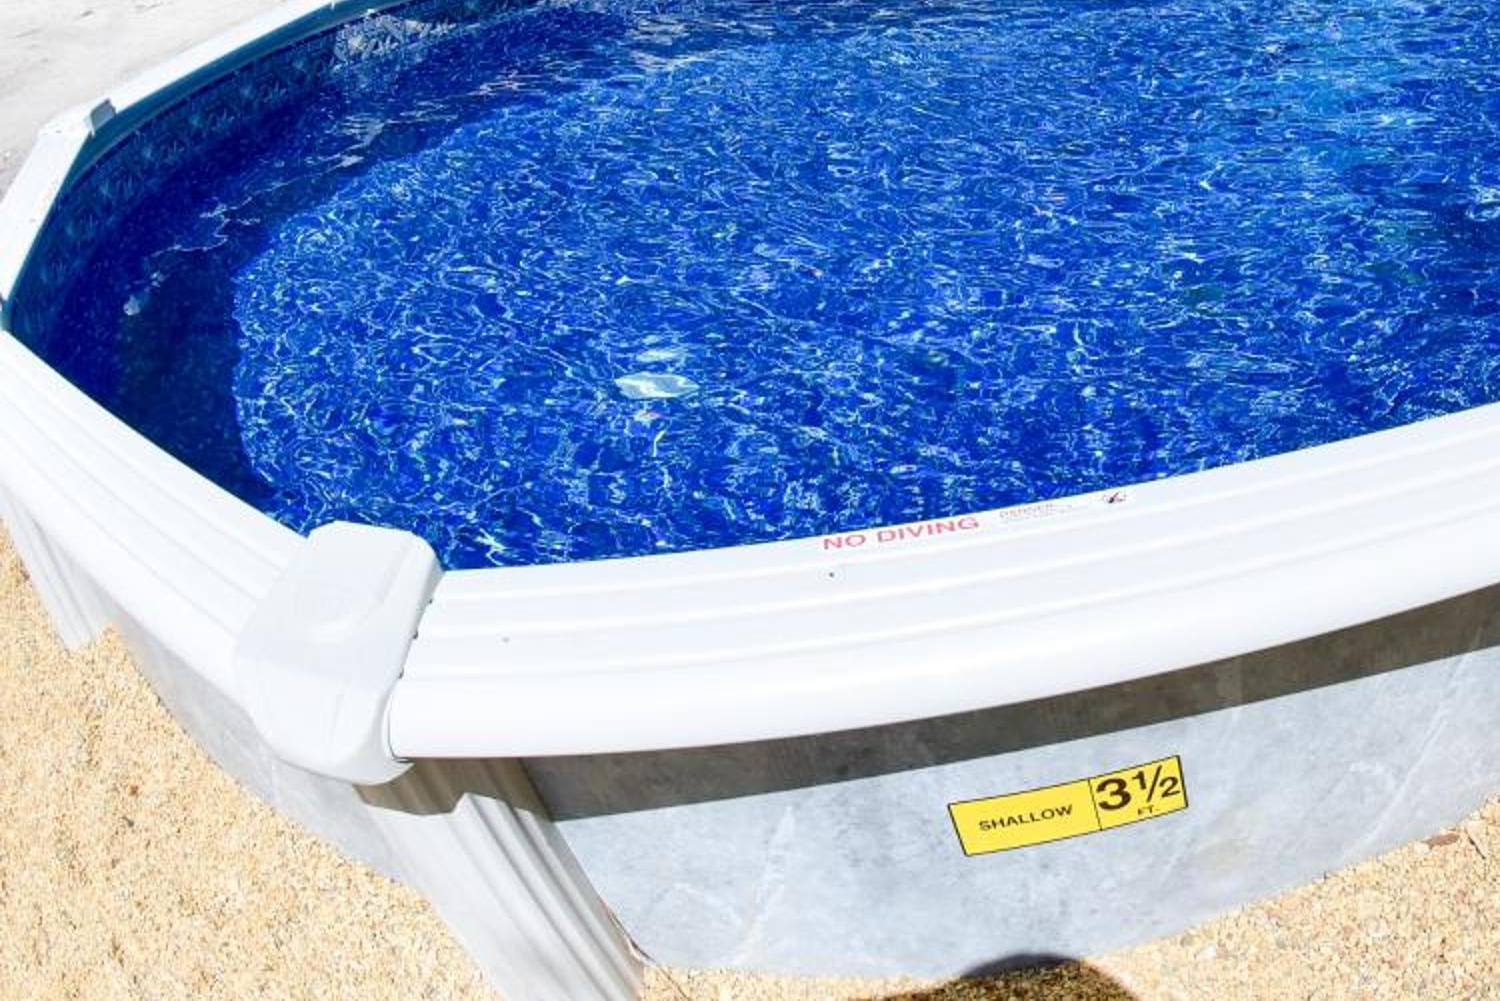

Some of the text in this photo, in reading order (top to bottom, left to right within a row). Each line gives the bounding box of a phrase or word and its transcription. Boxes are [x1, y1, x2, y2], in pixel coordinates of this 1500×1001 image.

[823, 517, 979, 550] NO DIVING
[979, 804, 1073, 832] SHALLOW
